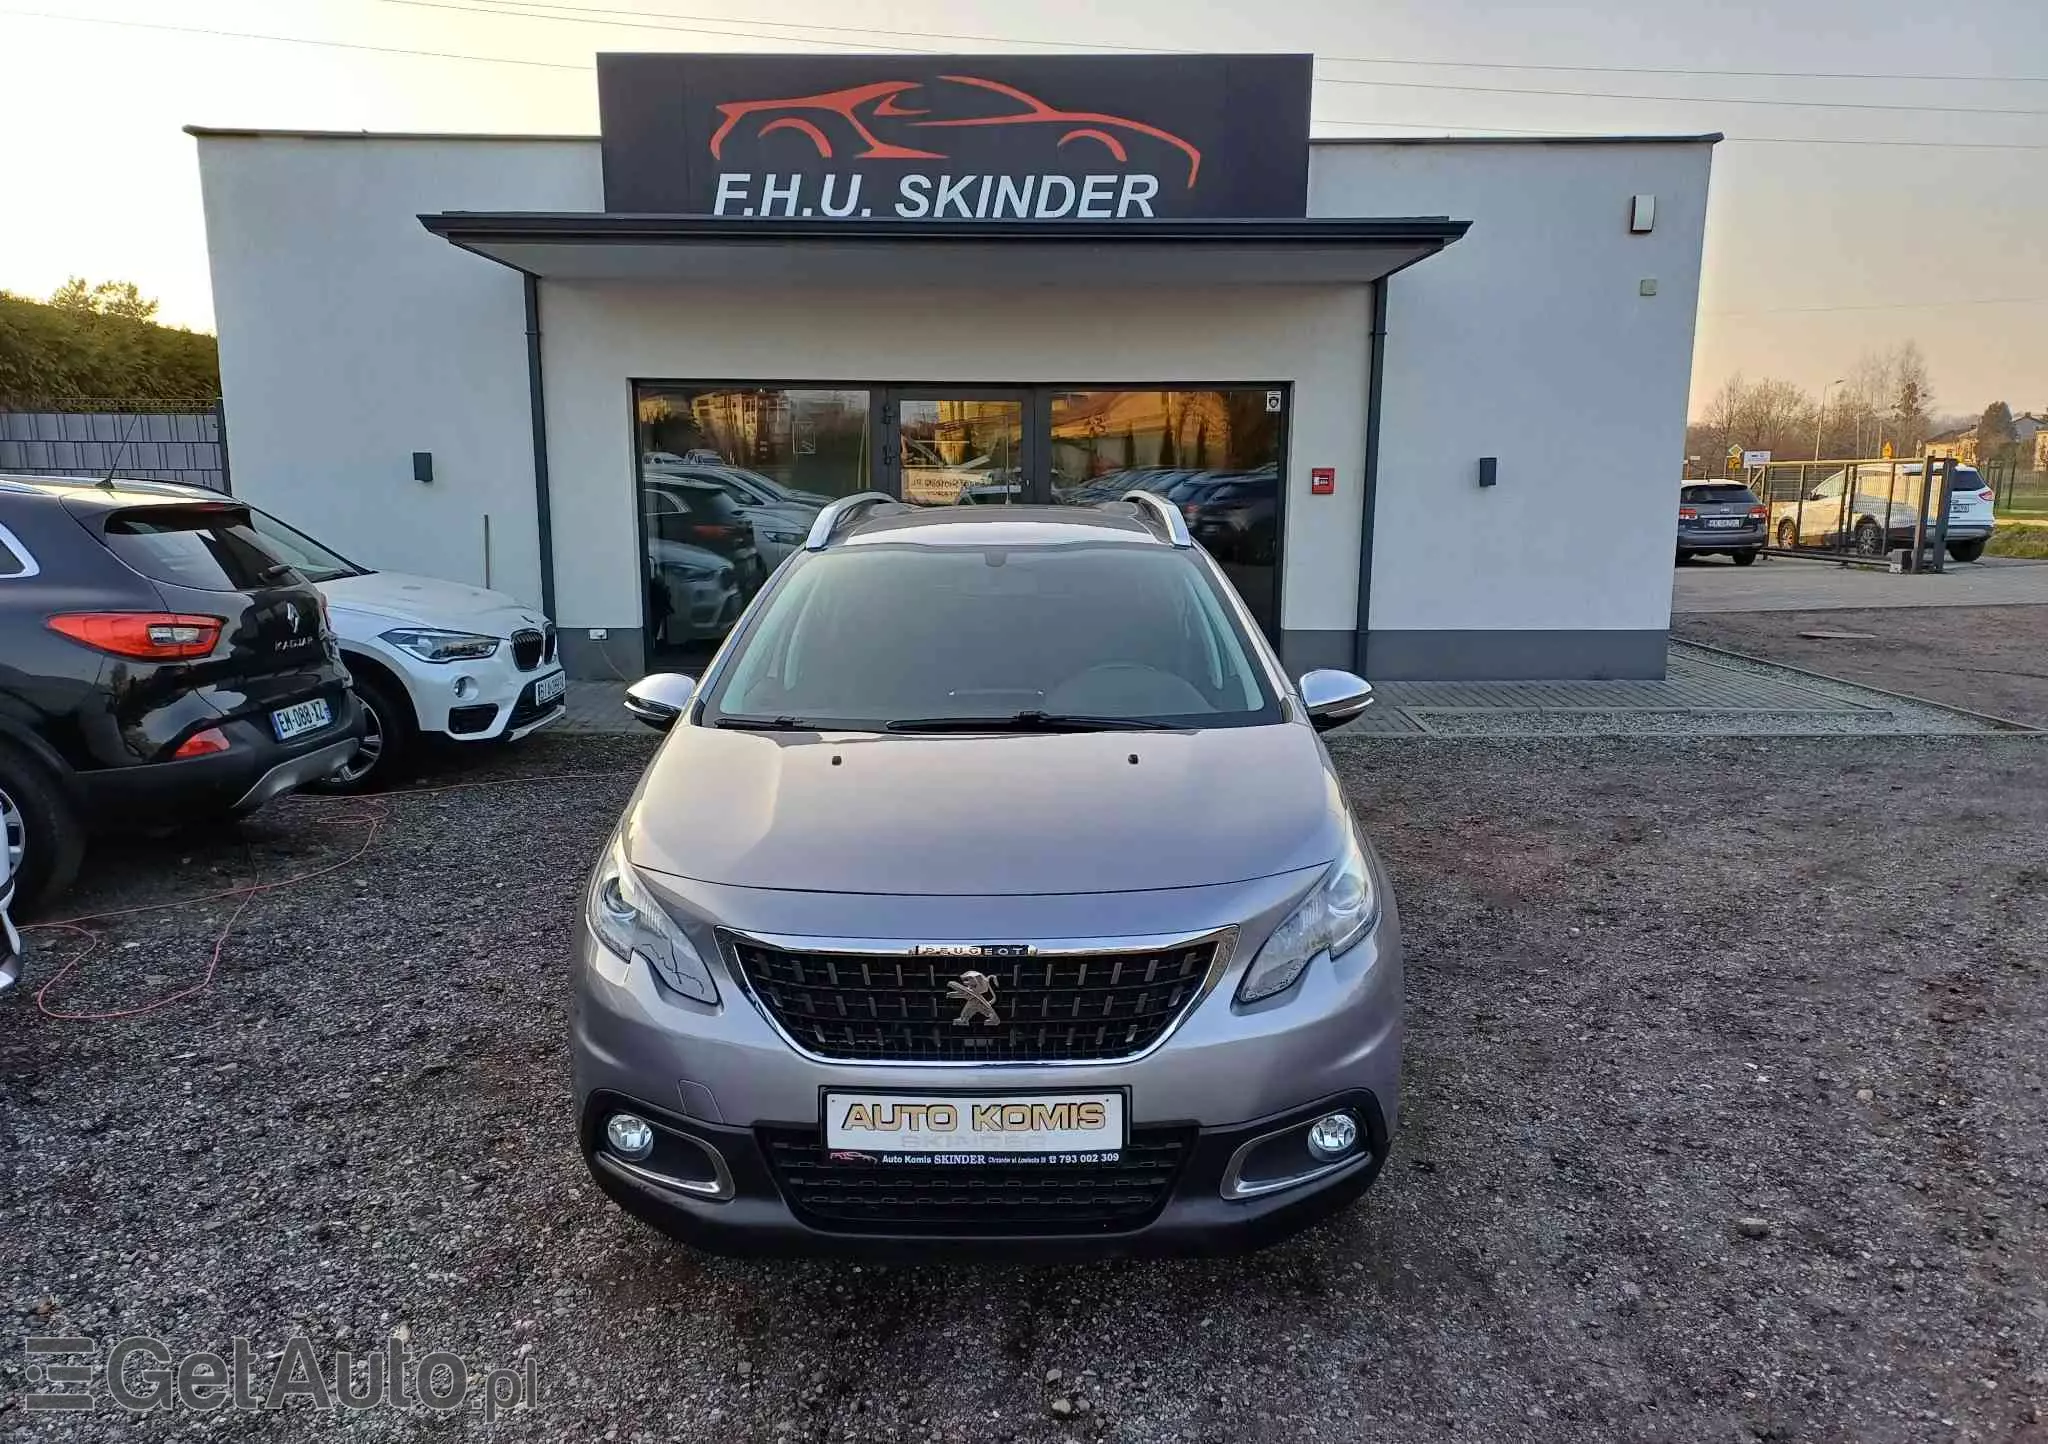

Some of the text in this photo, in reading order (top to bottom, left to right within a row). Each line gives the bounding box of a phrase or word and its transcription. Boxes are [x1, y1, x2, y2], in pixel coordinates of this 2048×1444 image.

[712, 173, 1160, 218] F.H.U. SKINDER
[841, 1102, 1106, 1131] AUTO KOMIS
[882, 1154, 903, 1164] Auto
[904, 1154, 932, 1164] Komis
[934, 1154, 986, 1165] SKINDER
[1059, 1154, 1078, 1164] 793
[1080, 1154, 1099, 1163] 002
[1101, 1152, 1120, 1162] 309
